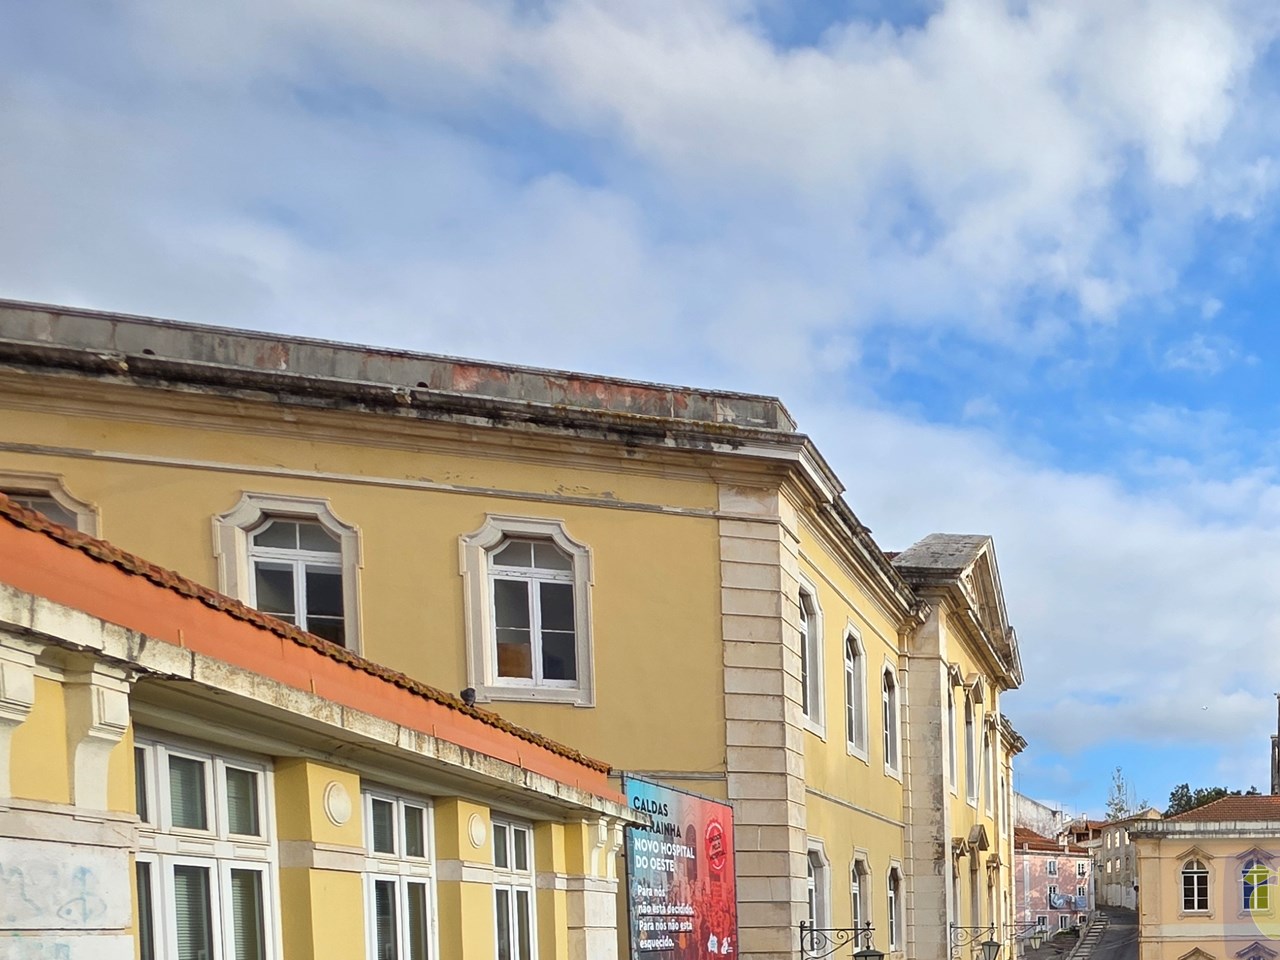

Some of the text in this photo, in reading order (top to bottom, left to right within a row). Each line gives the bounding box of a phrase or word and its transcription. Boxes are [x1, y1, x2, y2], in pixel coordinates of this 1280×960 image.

[633, 796, 668, 817] CALDAS
[650, 819, 682, 838] RAINHA
[634, 838, 659, 852] NOVO
[661, 842, 695, 859] HOSPITAL
[635, 855, 675, 872] DO OESTE
[637, 885, 653, 897] Para
[638, 901, 652, 914] não
[639, 920, 655, 931] Para
